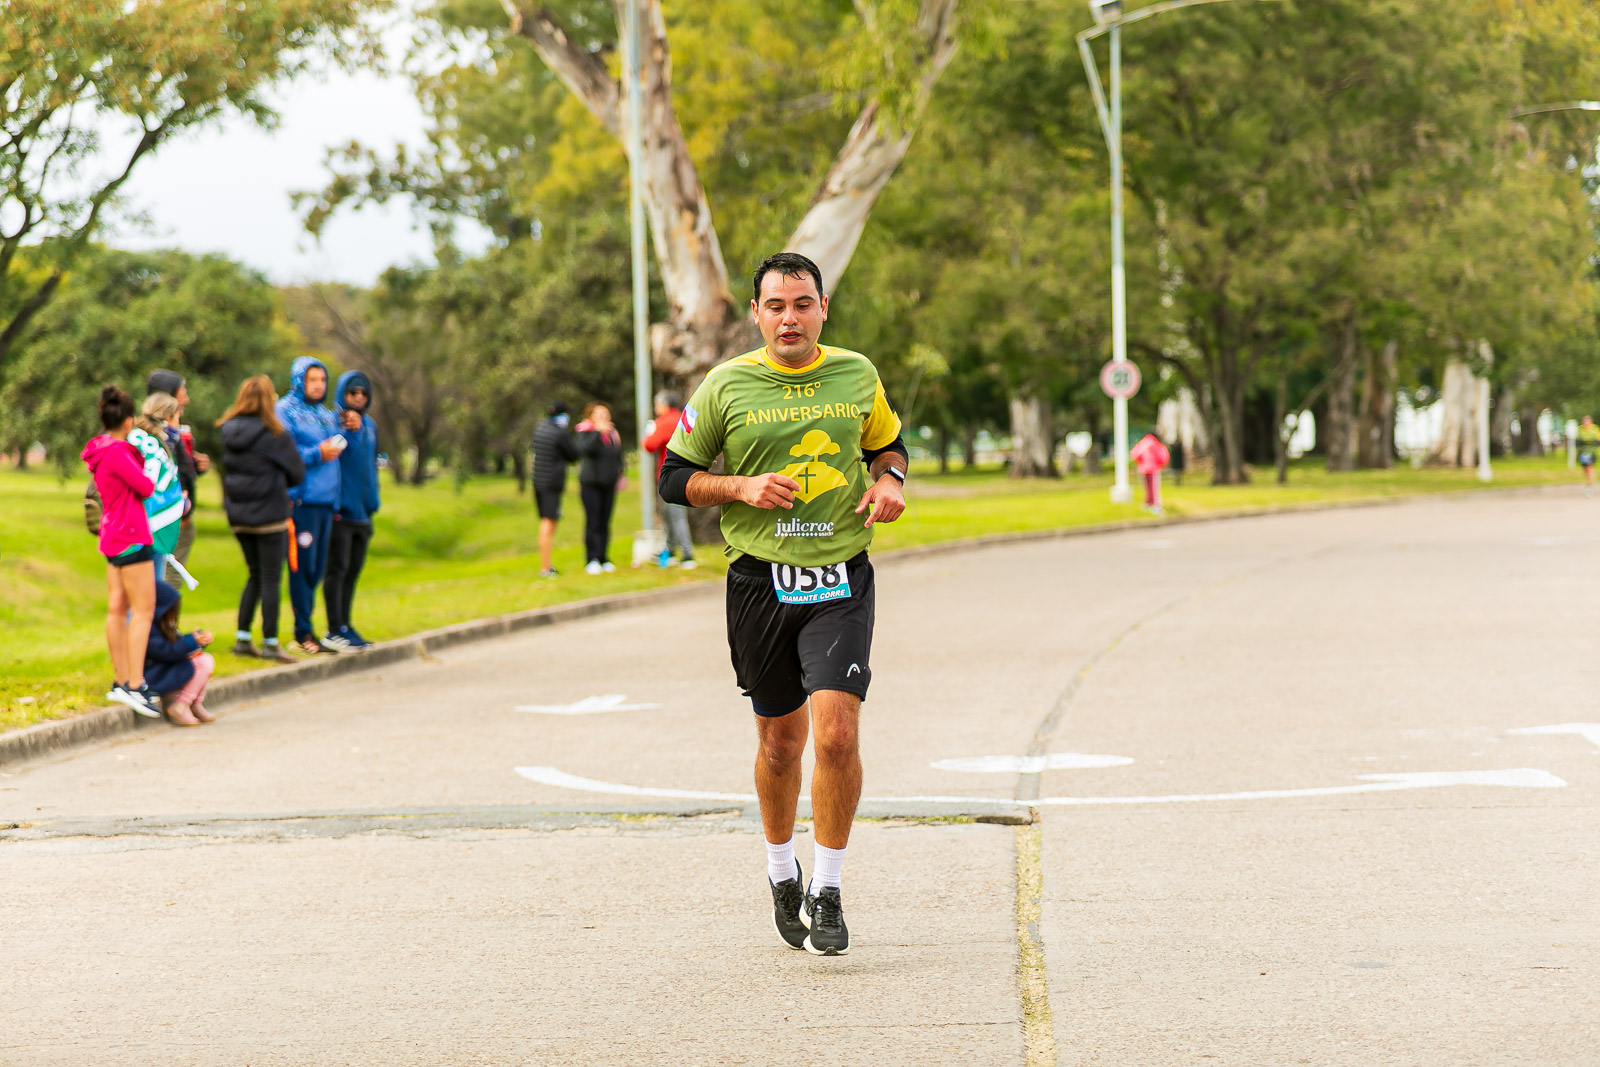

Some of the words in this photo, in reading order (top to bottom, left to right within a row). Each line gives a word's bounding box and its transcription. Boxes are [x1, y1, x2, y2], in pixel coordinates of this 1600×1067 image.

[782, 381, 821, 400] 216°
[745, 402, 861, 426] ANIVERSARIO
[774, 517, 834, 537] julicroc
[777, 563, 841, 594] 058
[781, 593, 818, 602] DIAMANTE
[819, 589, 846, 600] CORRE
